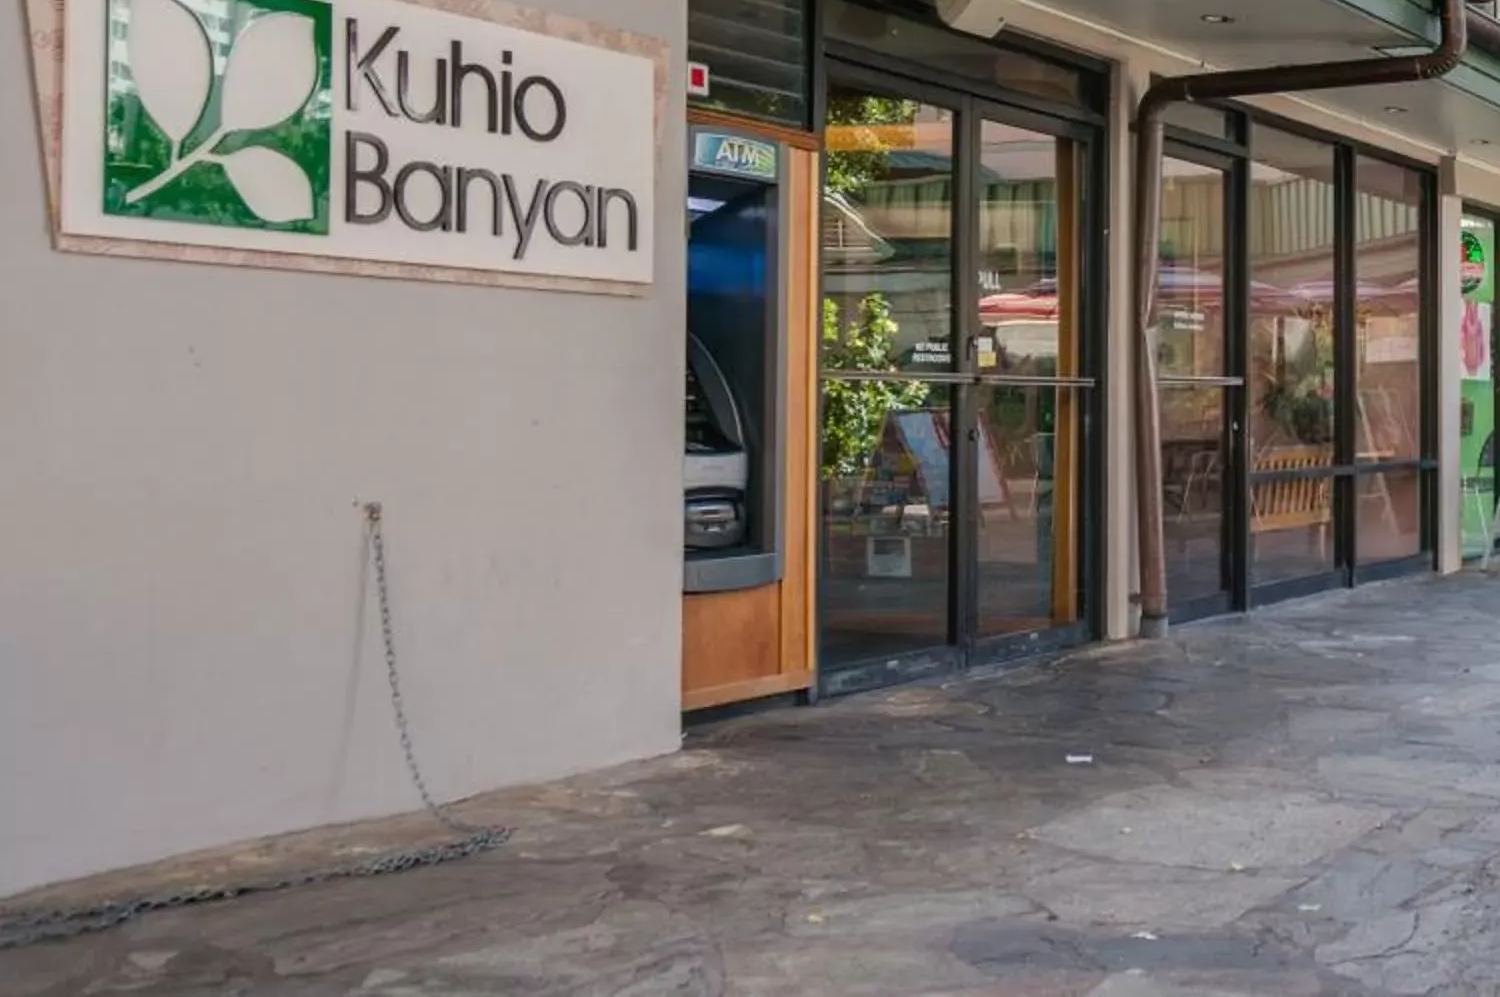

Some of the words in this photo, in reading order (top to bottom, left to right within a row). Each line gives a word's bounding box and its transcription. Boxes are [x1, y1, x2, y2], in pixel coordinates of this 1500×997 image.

[345, 17, 567, 143] Kuhio
[345, 130, 638, 260] Banyan
[715, 138, 760, 167] ATM
